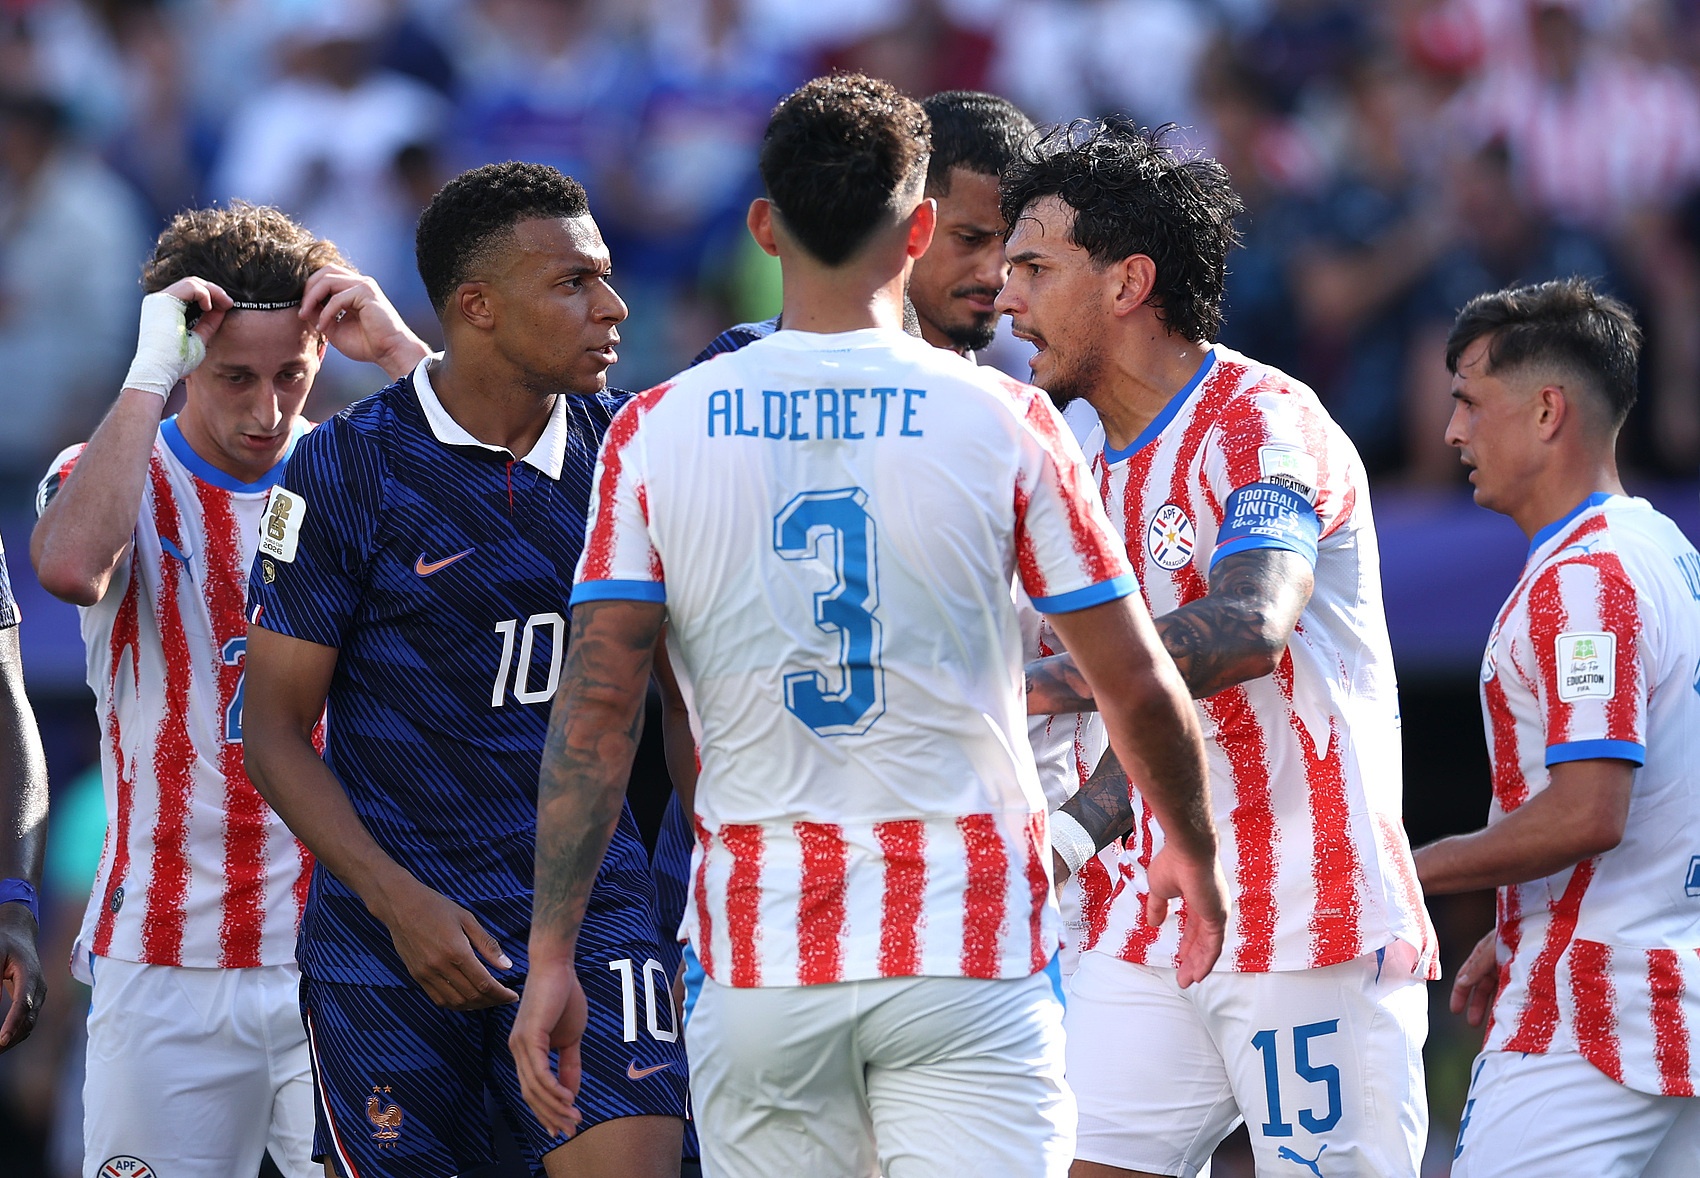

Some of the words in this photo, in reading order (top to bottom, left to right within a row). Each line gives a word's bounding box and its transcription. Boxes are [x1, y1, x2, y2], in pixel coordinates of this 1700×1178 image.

[272, 301, 290, 309] THREE
[707, 387, 927, 441] ALDERETE
[1237, 489, 1300, 514] FOOTBALL
[1162, 508, 1176, 520] APF
[1234, 501, 1300, 523] UNITES
[1230, 517, 1257, 529] the
[262, 541, 283, 555] 2026
[1162, 556, 1187, 567] PARAGUAY
[773, 486, 886, 738] 3
[492, 612, 565, 707] 10
[1566, 673, 1605, 687] EDUCATION
[608, 958, 679, 1043] 10
[1250, 1018, 1343, 1137] 15
[115, 1160, 136, 1171] APF
